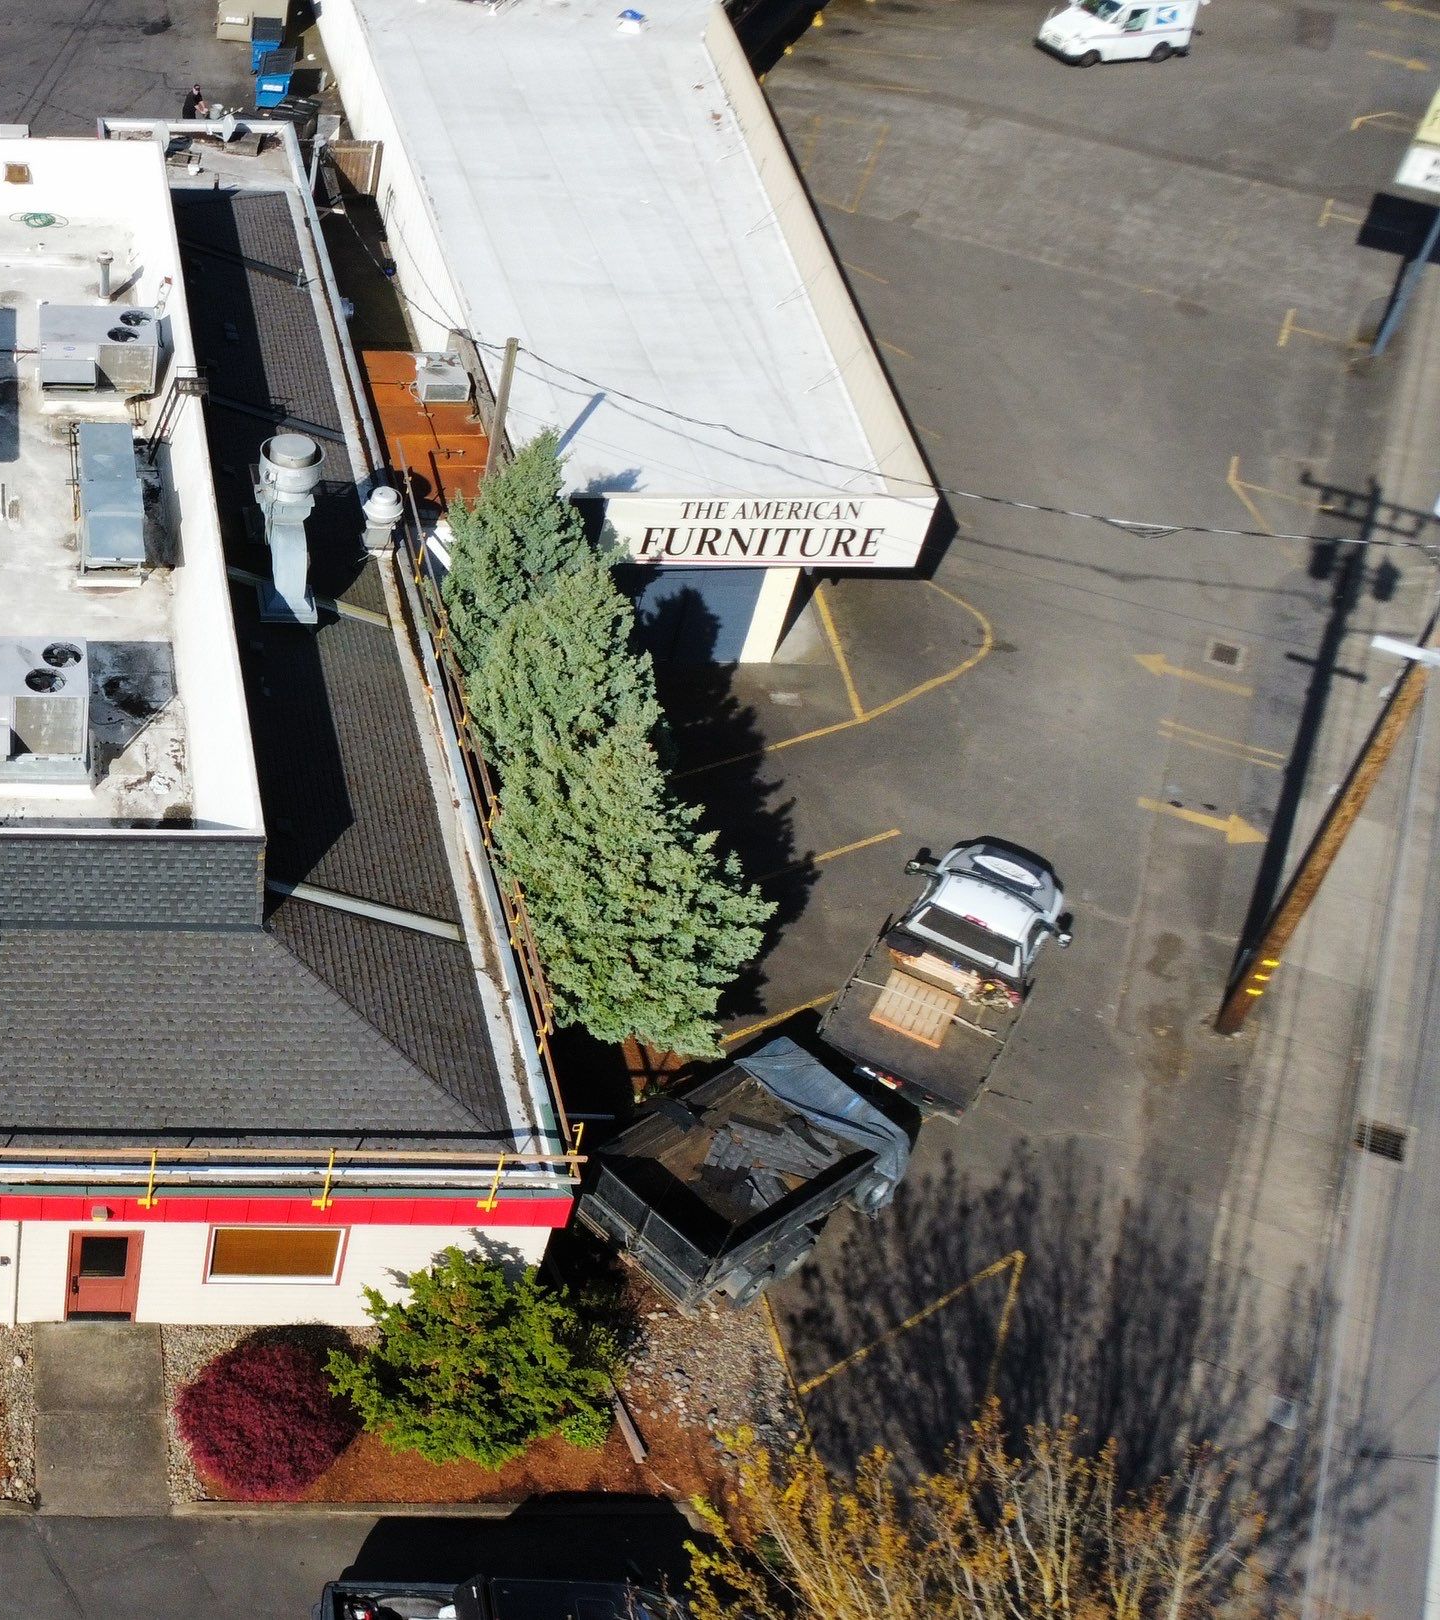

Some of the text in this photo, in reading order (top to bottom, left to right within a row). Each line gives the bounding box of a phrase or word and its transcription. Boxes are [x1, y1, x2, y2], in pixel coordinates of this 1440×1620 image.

[680, 501, 864, 520] THE AMERICAN
[637, 527, 885, 557] FURNITURE
